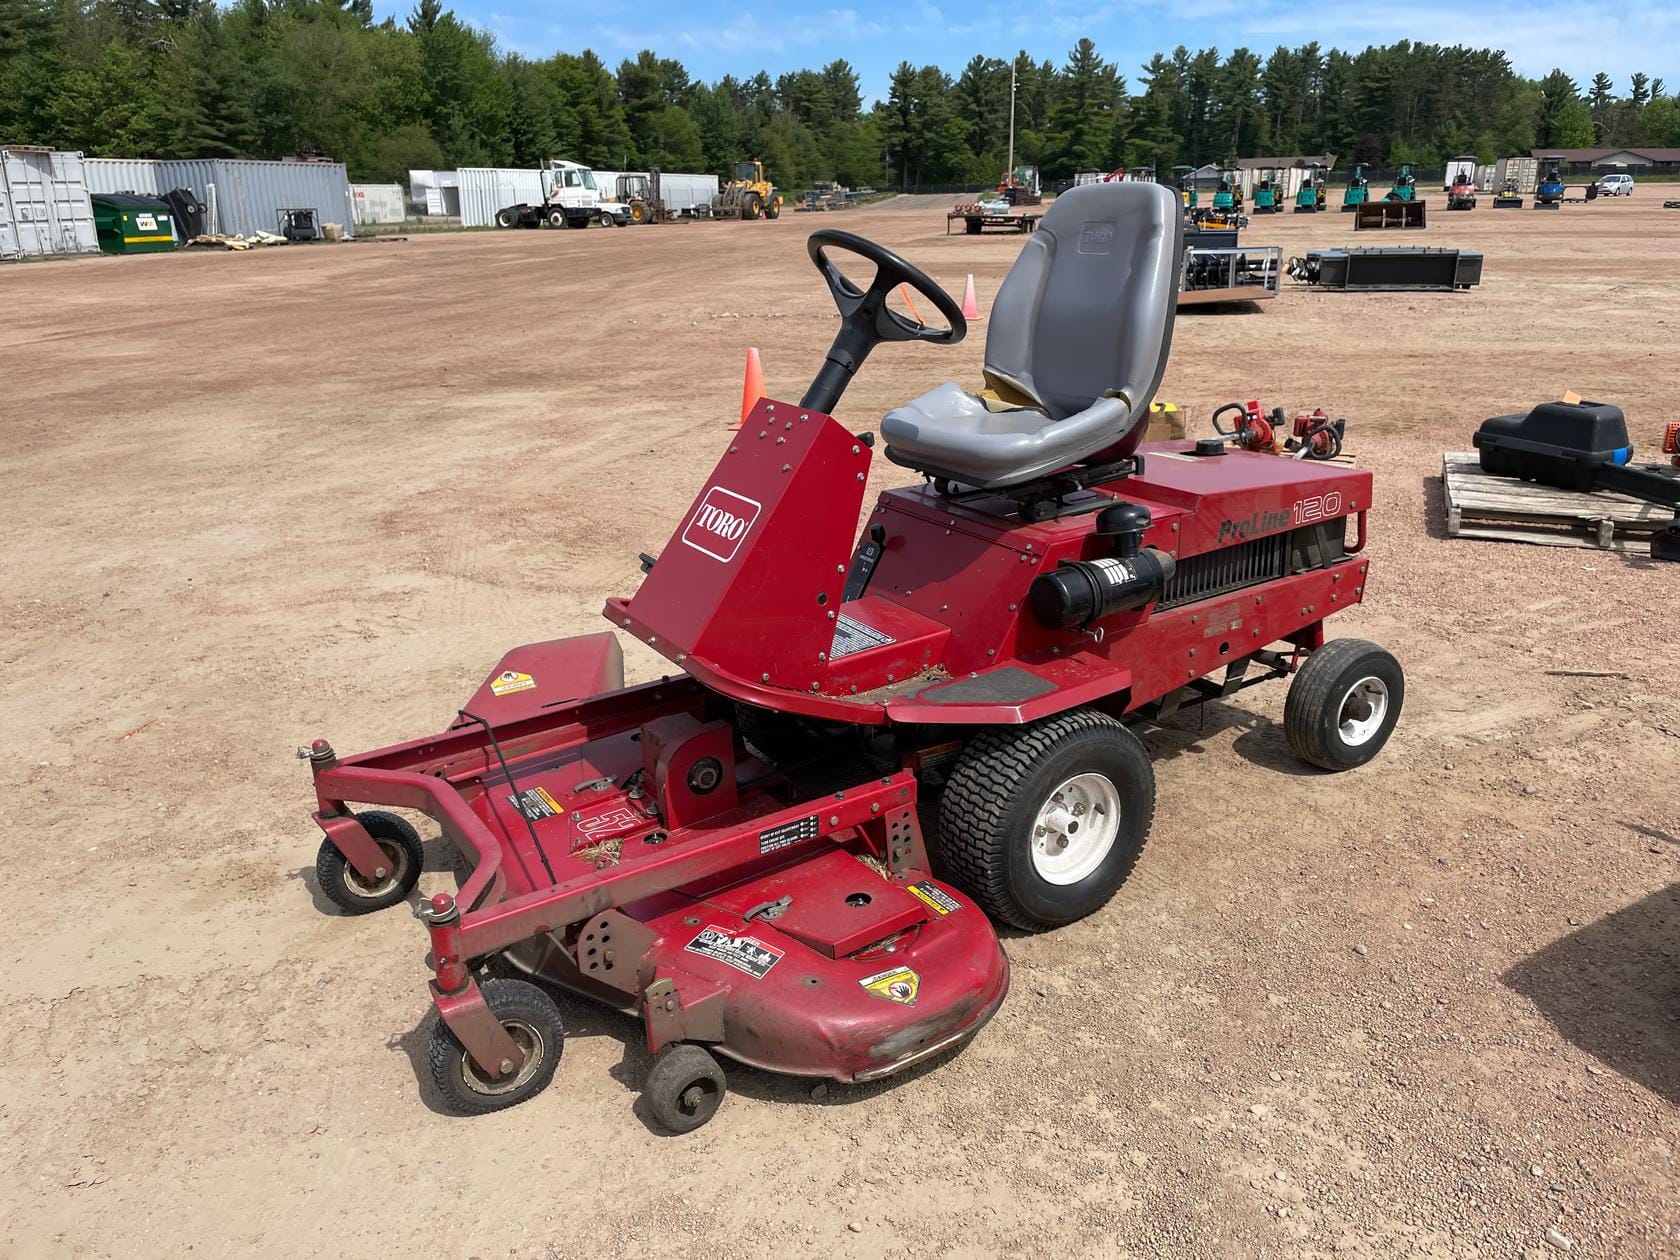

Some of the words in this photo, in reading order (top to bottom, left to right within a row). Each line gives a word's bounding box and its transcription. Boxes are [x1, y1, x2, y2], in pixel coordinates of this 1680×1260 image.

[696, 504, 746, 541] TORO
[1217, 508, 1290, 544] ProLine
[1293, 491, 1342, 525] 120
